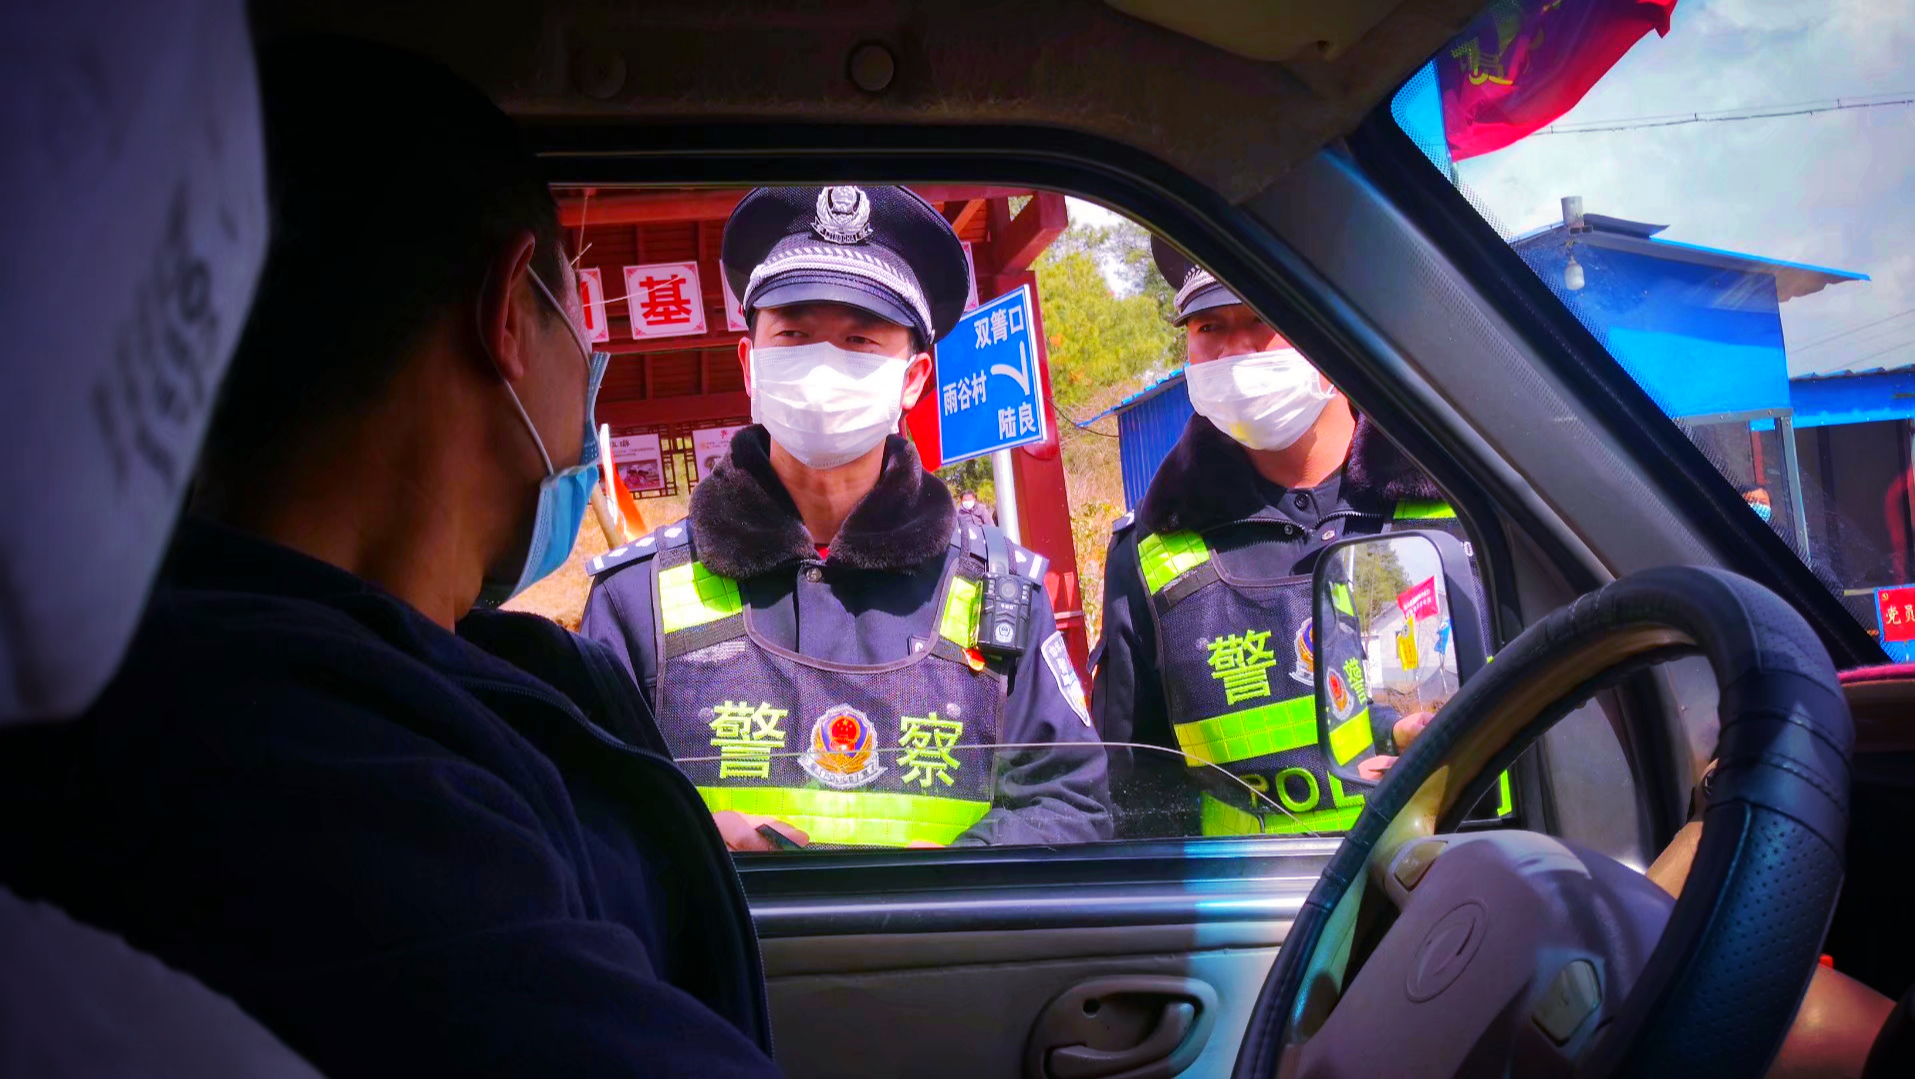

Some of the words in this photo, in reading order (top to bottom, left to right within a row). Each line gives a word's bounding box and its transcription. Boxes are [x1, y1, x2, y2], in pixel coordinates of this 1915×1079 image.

[974, 304, 1024, 349] 双箐口
[943, 369, 987, 416] 雨谷村
[998, 401, 1036, 440] 陆良
[1207, 629, 1277, 706] 警
[709, 701, 789, 779] 警
[899, 711, 963, 787] 察
[1239, 767, 1366, 812] POL
